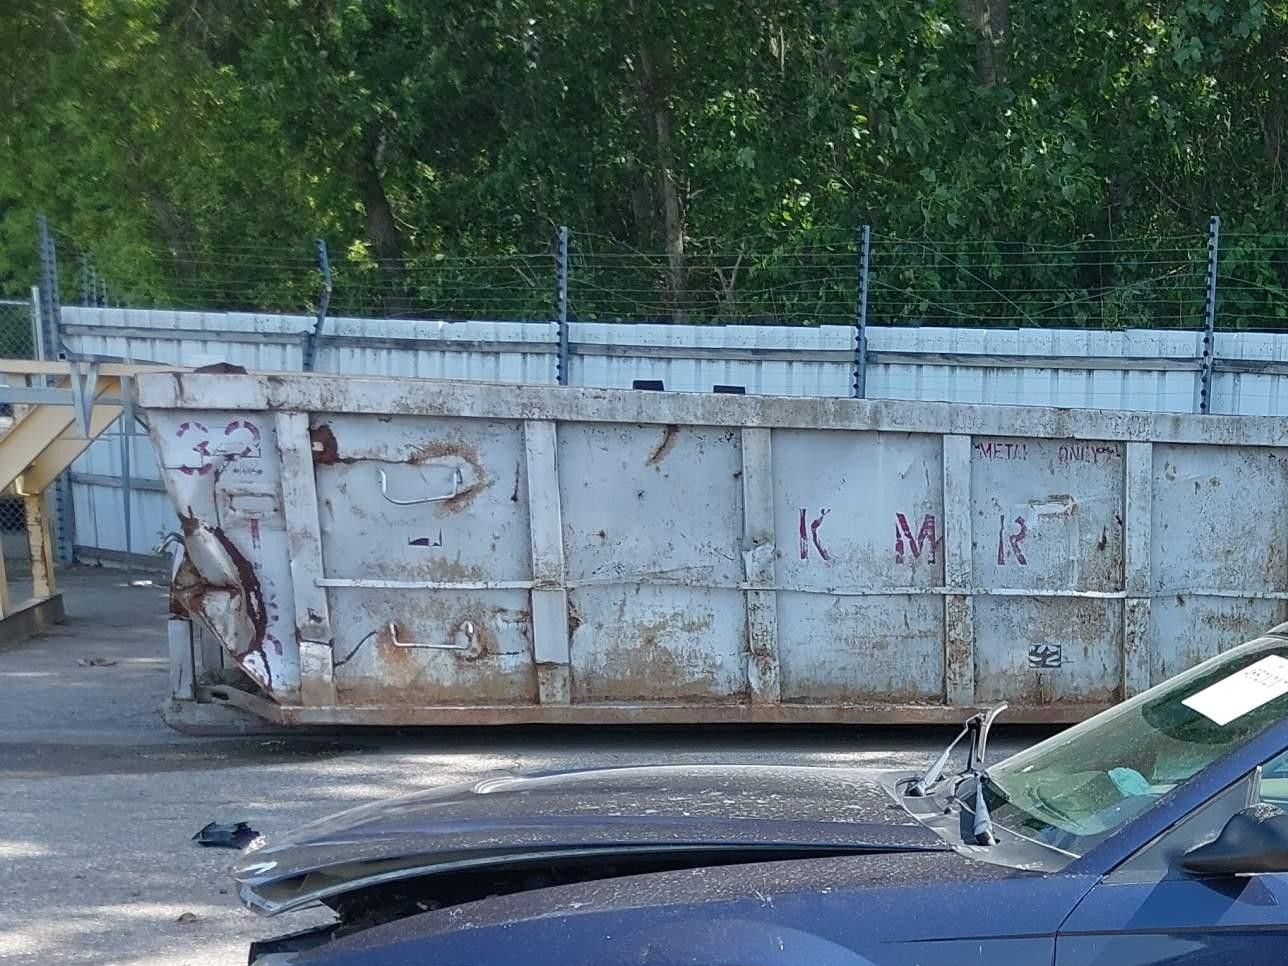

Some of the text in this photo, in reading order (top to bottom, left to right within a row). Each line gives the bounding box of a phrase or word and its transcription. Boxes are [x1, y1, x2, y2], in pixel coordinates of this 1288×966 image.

[799, 508, 1028, 566] K M R
